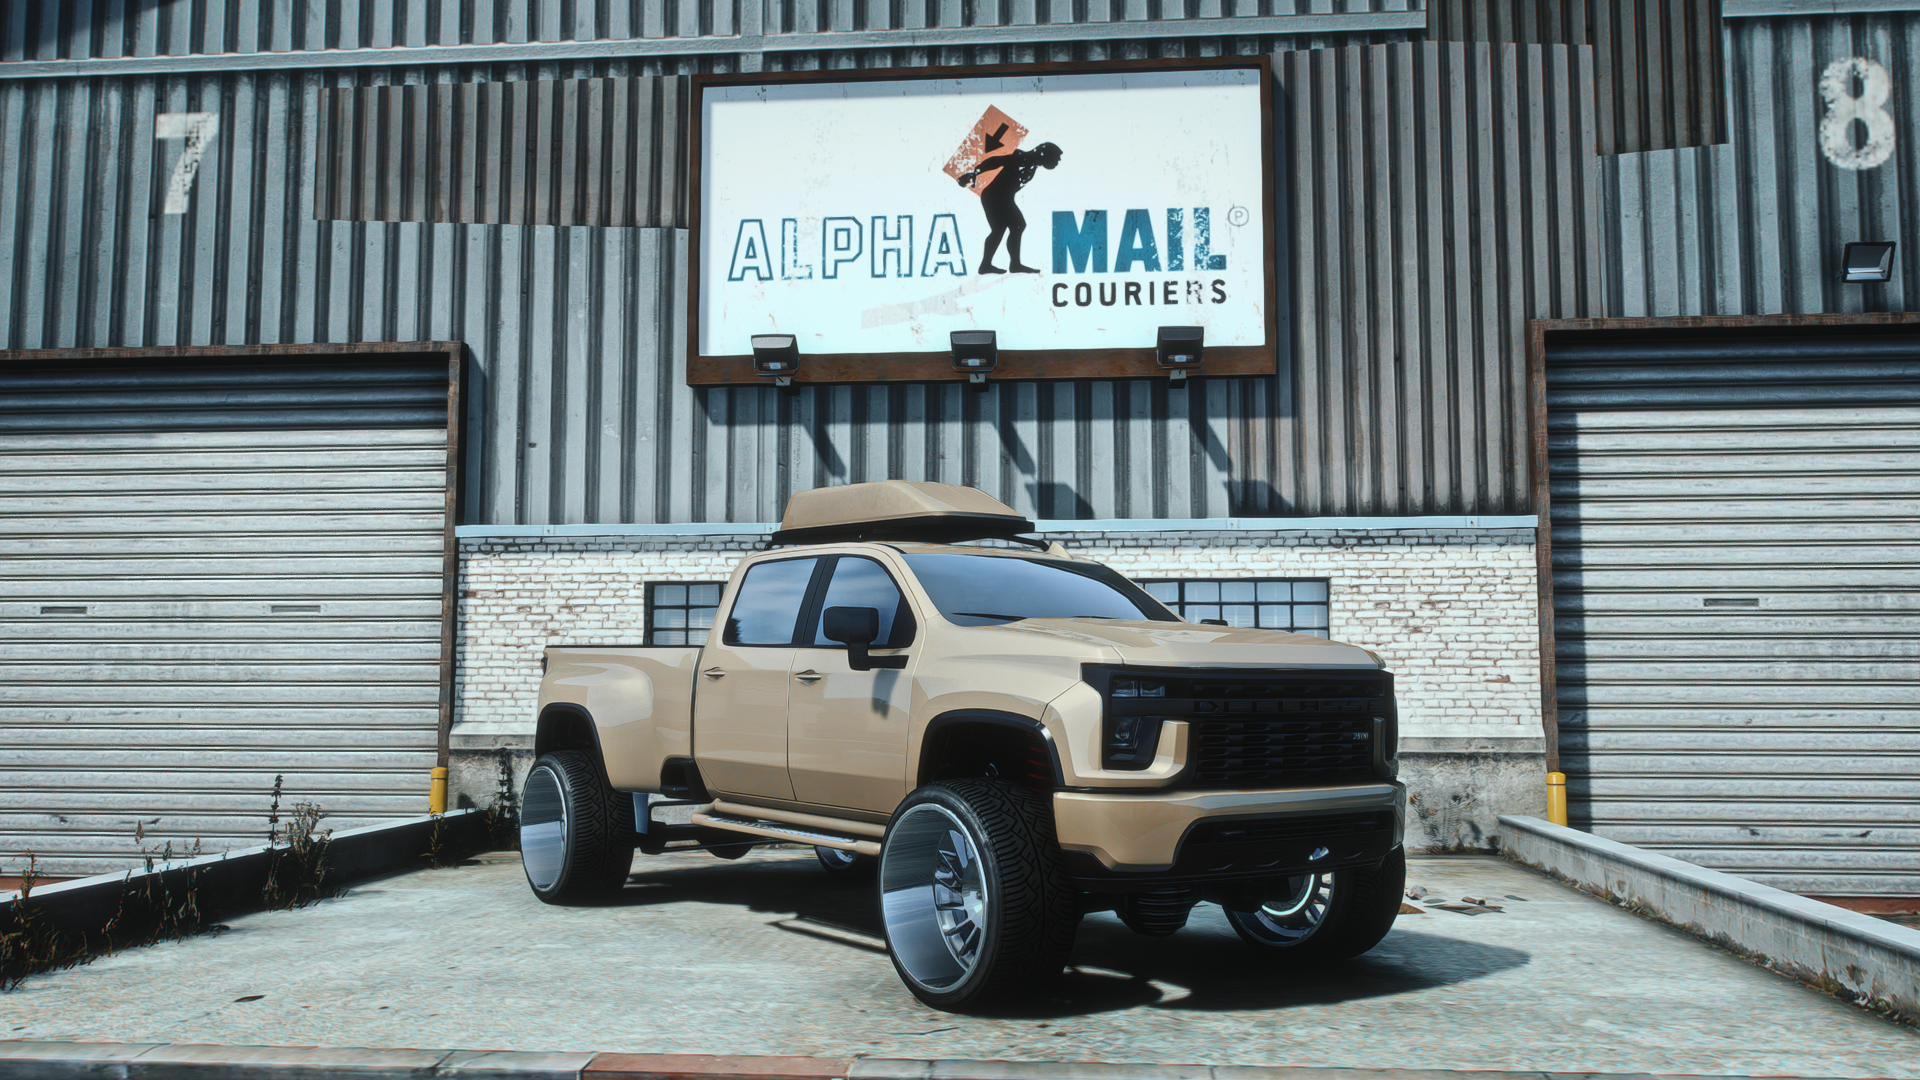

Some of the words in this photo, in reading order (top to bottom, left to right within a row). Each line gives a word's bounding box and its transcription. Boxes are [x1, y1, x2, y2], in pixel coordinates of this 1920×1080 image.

[1819, 57, 1895, 170] 8
[156, 113, 218, 214] 7
[728, 213, 967, 282] ALPHA
[1052, 207, 1227, 273] MAIL
[1053, 279, 1227, 307] COURIERS
